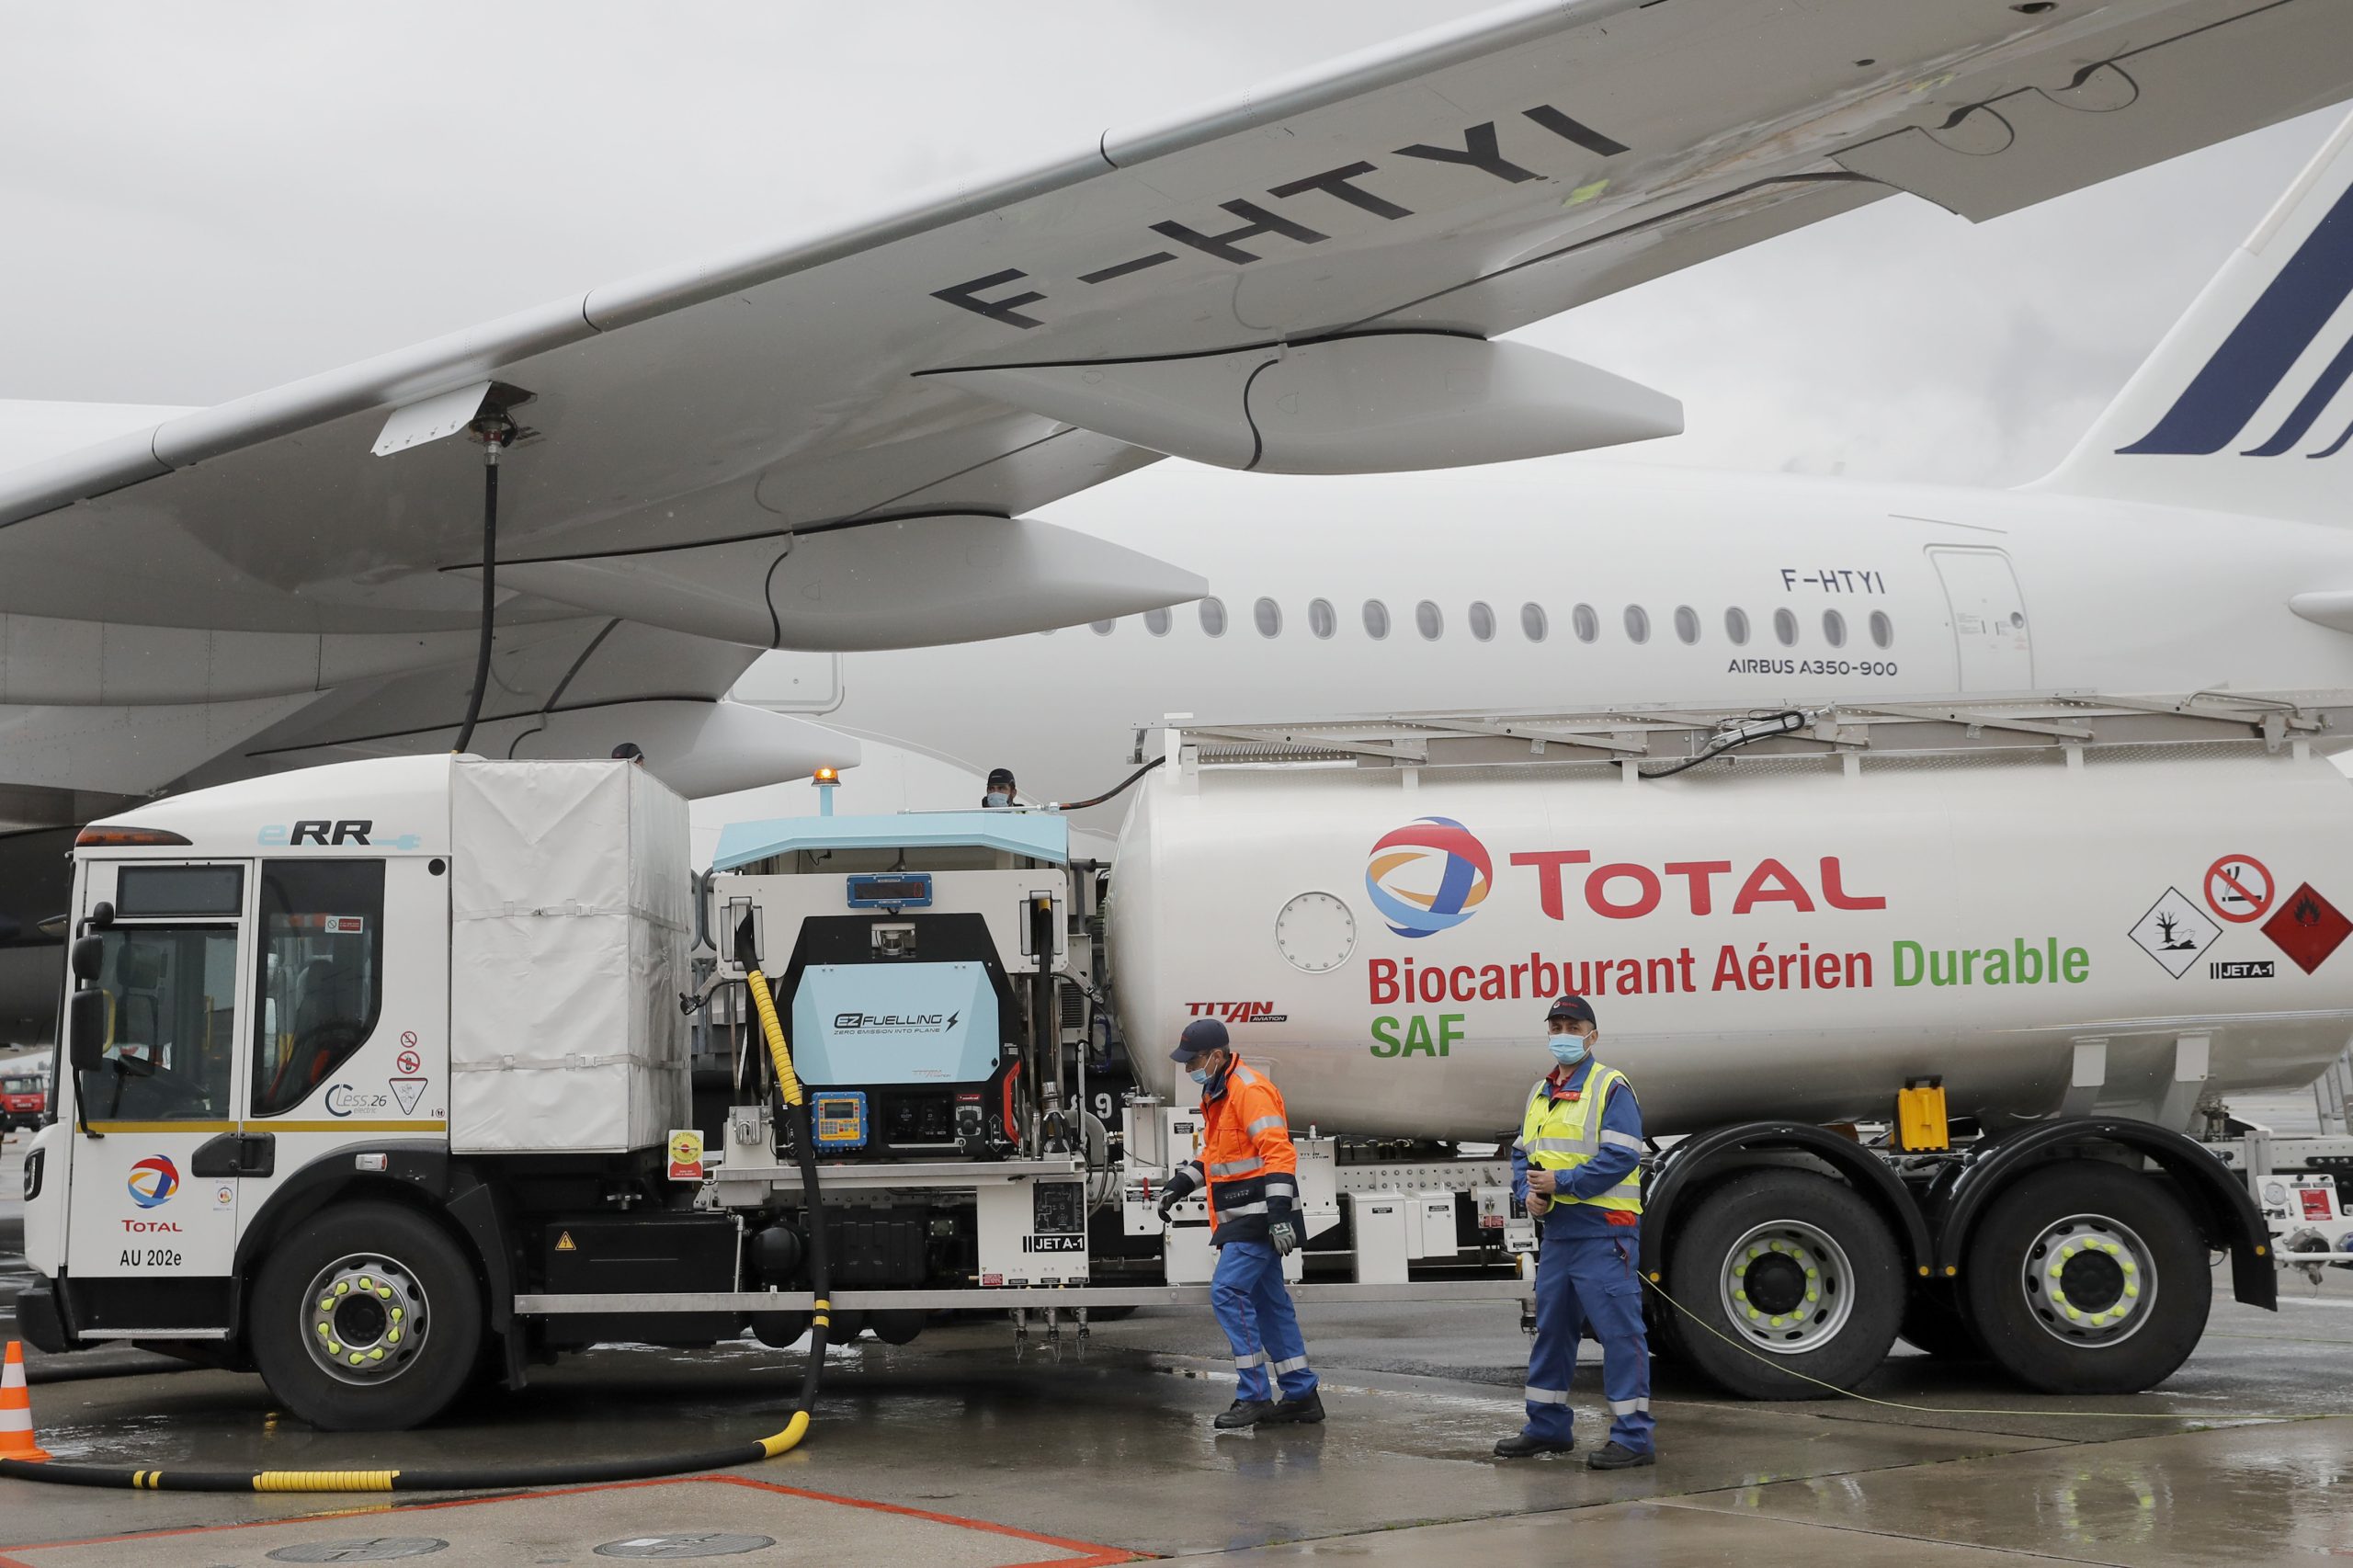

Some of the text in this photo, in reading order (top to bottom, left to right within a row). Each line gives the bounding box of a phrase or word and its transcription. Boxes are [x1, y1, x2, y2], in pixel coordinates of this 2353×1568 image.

[929, 104, 1631, 329] F-HTYI
[1780, 568, 1885, 595] F-HTYI
[1727, 659, 1898, 676] AIRBUS A350-900
[1510, 849, 1887, 920] TOTAL
[1369, 937, 2090, 1006] Biocarburant Aérien Durable
[2222, 963, 2273, 976] JET A-1
[1185, 1001, 1274, 1023] TITAN
[1370, 1013, 1465, 1059] SAF
[121, 1220, 183, 1233] TOTAL
[1036, 1237, 1084, 1249] JET A-1
[119, 1249, 182, 1267] AU 202e
